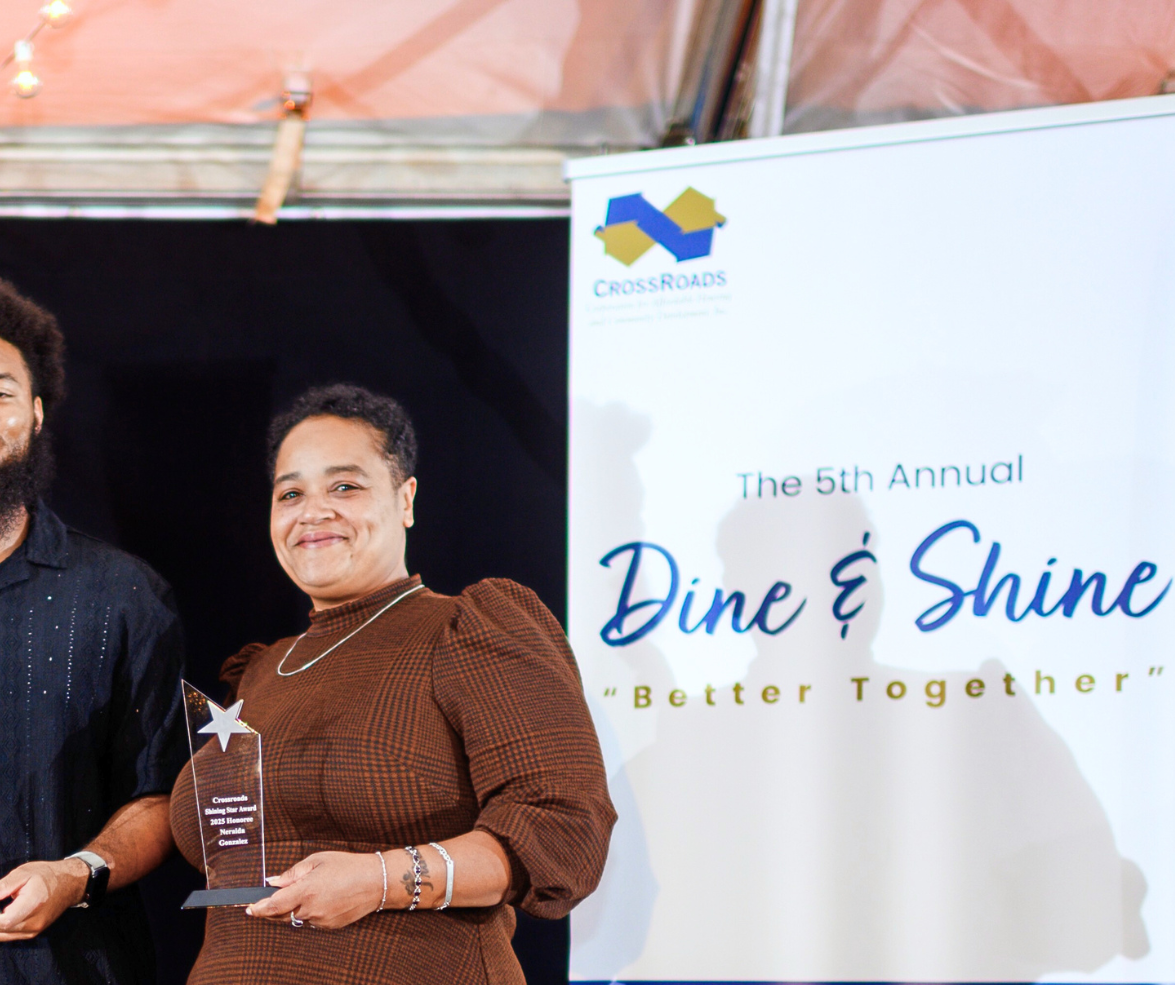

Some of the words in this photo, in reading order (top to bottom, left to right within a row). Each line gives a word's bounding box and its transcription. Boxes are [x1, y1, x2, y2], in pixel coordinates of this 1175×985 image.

[737, 471, 803, 501] The
[815, 466, 875, 497] 5th
[888, 453, 1024, 490] Annual
[598, 539, 807, 648] Dine
[829, 531, 877, 640] &
[908, 519, 1174, 633] Shine
[213, 795, 248, 803] Crossroads
